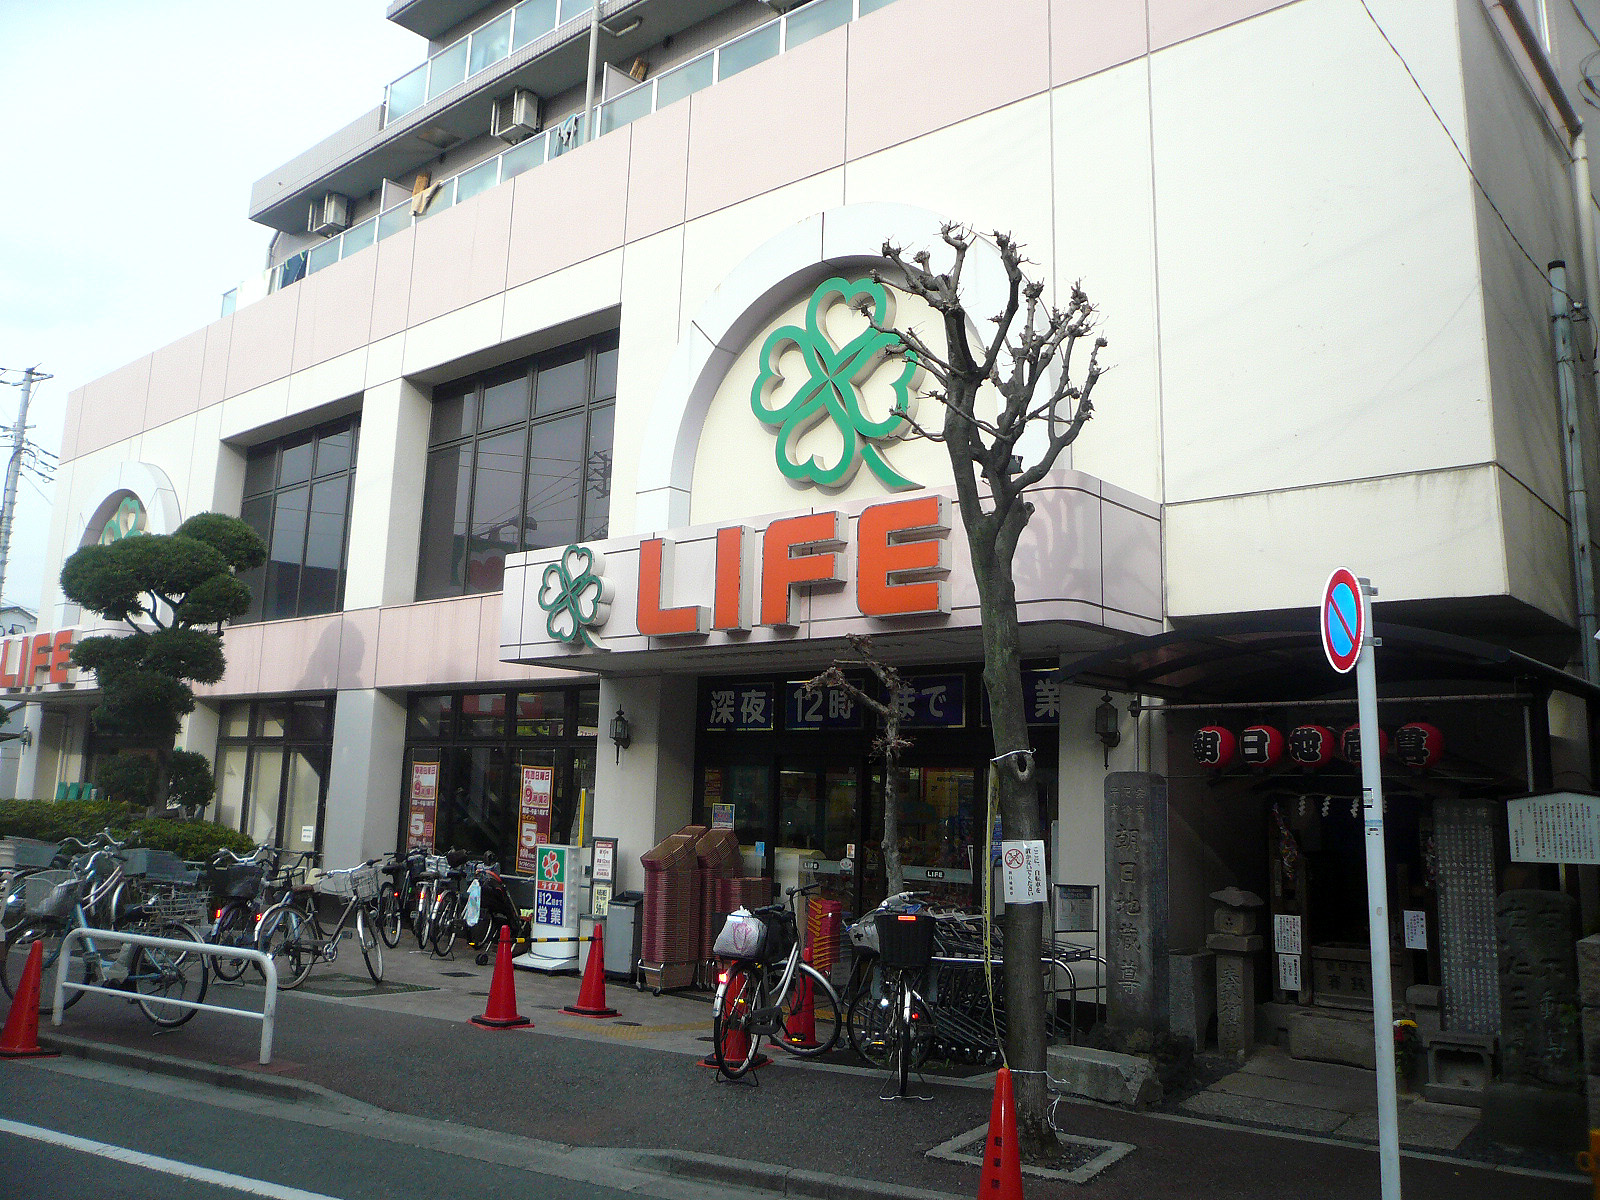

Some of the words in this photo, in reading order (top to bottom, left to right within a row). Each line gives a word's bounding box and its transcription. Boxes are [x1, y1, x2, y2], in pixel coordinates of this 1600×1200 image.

[636, 494, 952, 637] LIFE
[0, 629, 78, 688] LIFE
[538, 905, 562, 925] 営業
[541, 882, 559, 890] ライフ
[1113, 824, 1142, 995] 朝日地蔵尊
